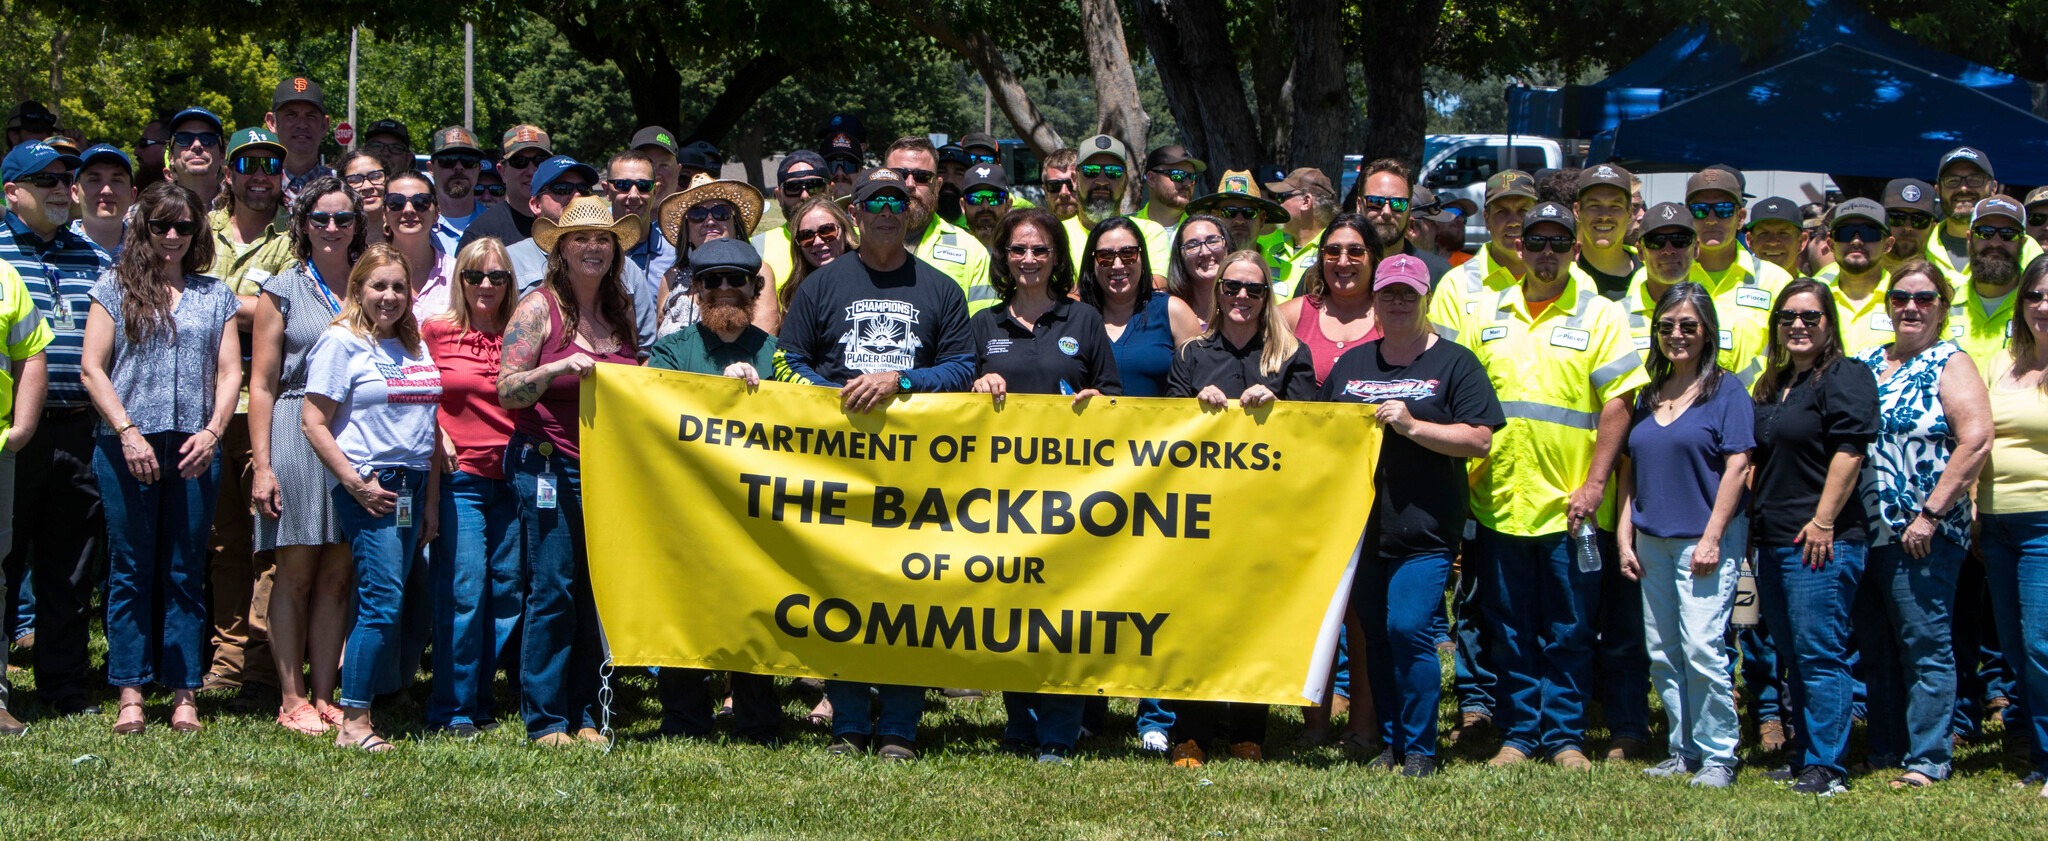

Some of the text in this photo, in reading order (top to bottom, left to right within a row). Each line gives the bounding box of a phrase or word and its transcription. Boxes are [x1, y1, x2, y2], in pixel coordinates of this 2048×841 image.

[248, 130, 268, 144] A's
[336, 129, 353, 139] STOP
[1746, 294, 1767, 302] Placer
[855, 301, 911, 315] CHAMPIONS
[1563, 333, 1585, 342] Placer
[847, 353, 914, 368] PLACER COUNTY
[677, 414, 1282, 472] DEPARTMENT OF PUBLIC WORKS:
[739, 473, 1213, 540] THE BACKBONE
[901, 552, 1046, 585] OF OUR
[773, 593, 1171, 657] COMMUNITY
